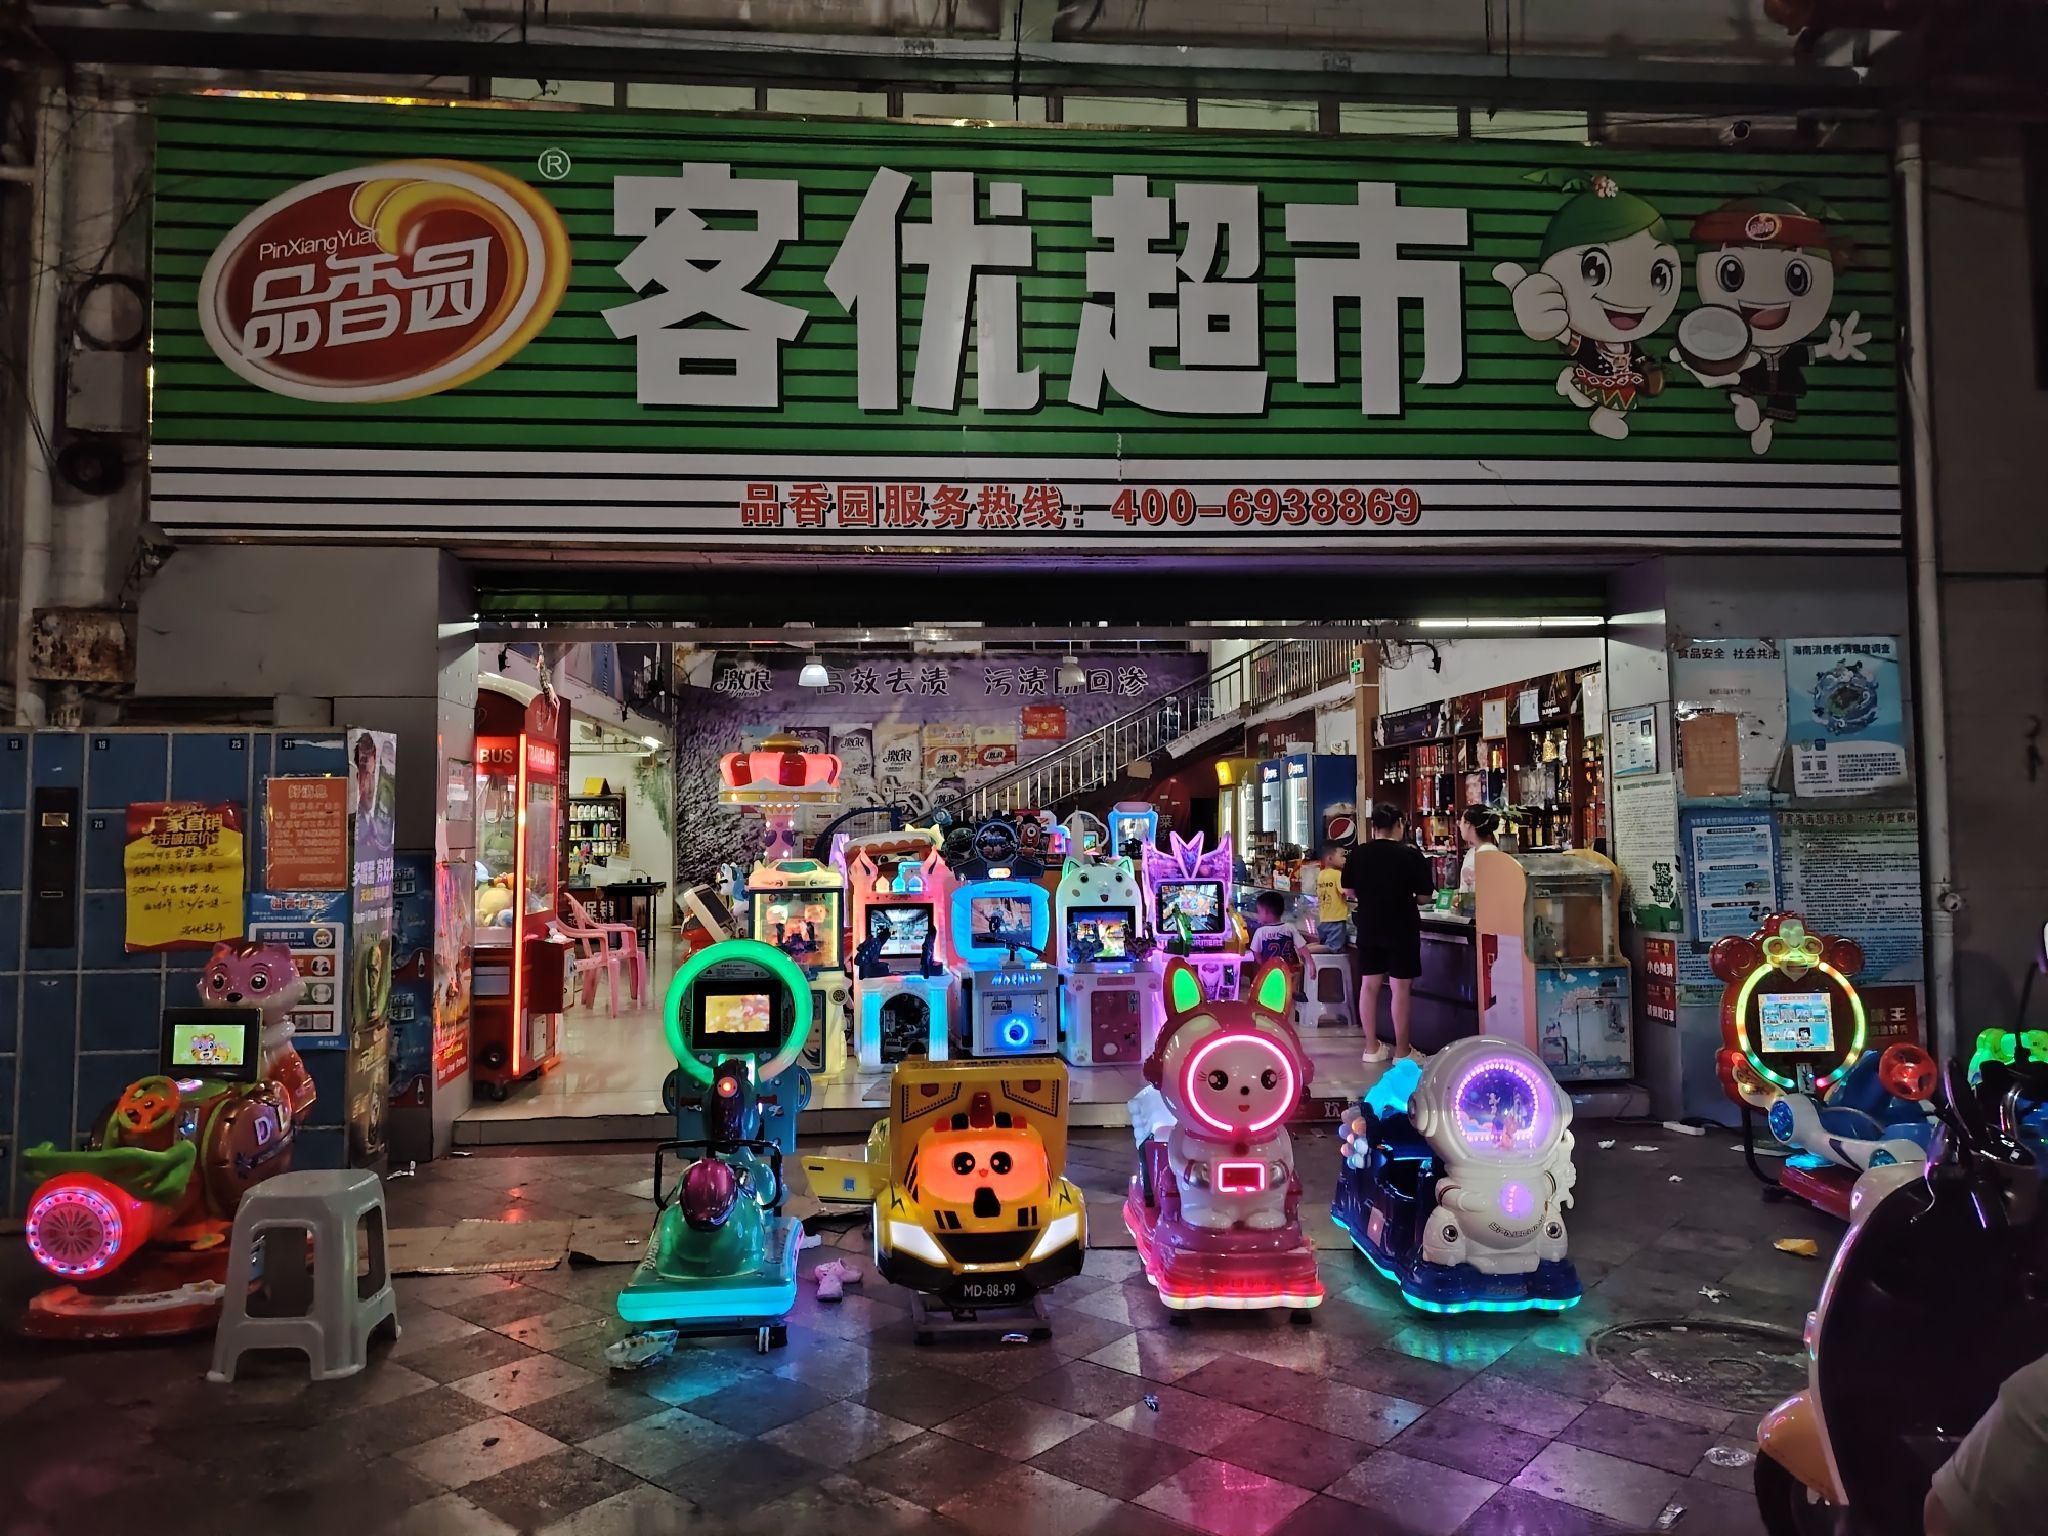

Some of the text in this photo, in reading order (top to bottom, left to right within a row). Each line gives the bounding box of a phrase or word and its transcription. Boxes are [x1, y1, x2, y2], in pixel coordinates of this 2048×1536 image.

[241, 235, 492, 359] 品香园
[600, 160, 1470, 418] 客优超市
[814, 666, 951, 697] 高效去渍
[479, 748, 513, 764] BUS
[962, 1282, 1017, 1298] MD-88-99
